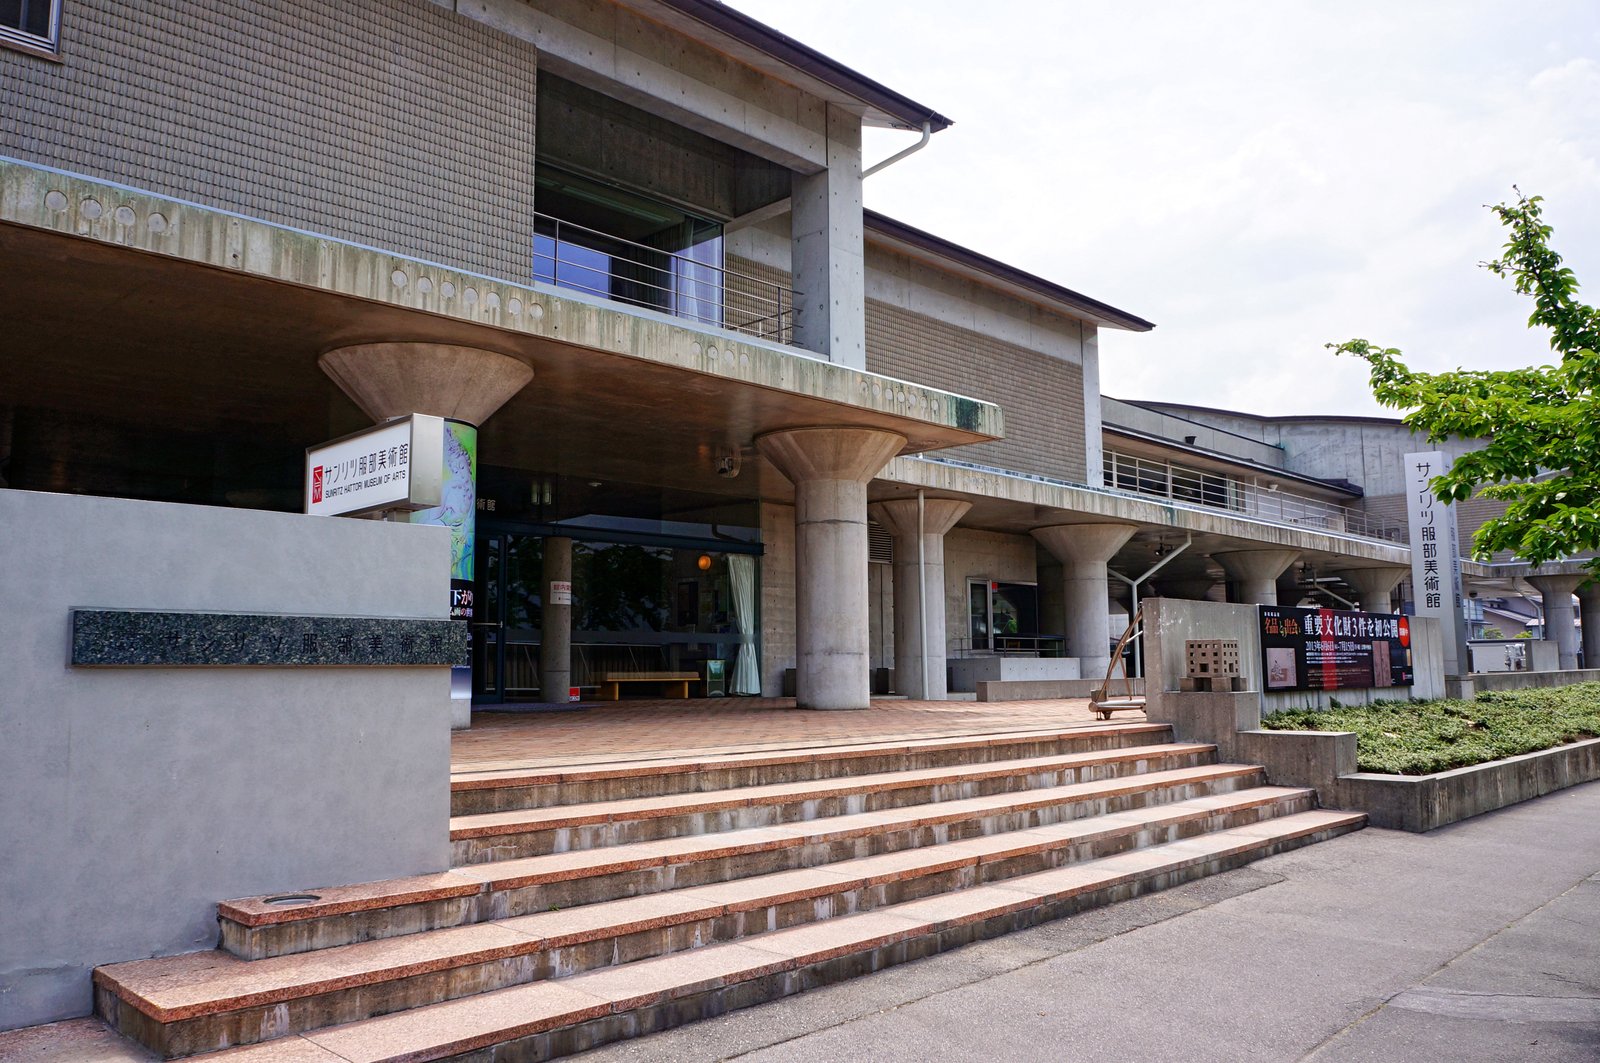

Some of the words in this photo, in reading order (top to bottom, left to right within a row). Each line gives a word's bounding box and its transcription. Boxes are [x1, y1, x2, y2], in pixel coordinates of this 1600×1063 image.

[325, 443, 408, 485] サンリツ服部美術館
[325, 486, 343, 498] SUNRITZ
[344, 481, 362, 493] HATTORI
[364, 475, 382, 488] MUSEUM
[384, 473, 391, 483] OF
[392, 470, 406, 481] ARTS
[1416, 462, 1441, 608] サンリツ服部美術館
[1304, 613, 1399, 639] 重要文化財3件を初公開
[165, 631, 442, 655] サンリツ服部美術館
